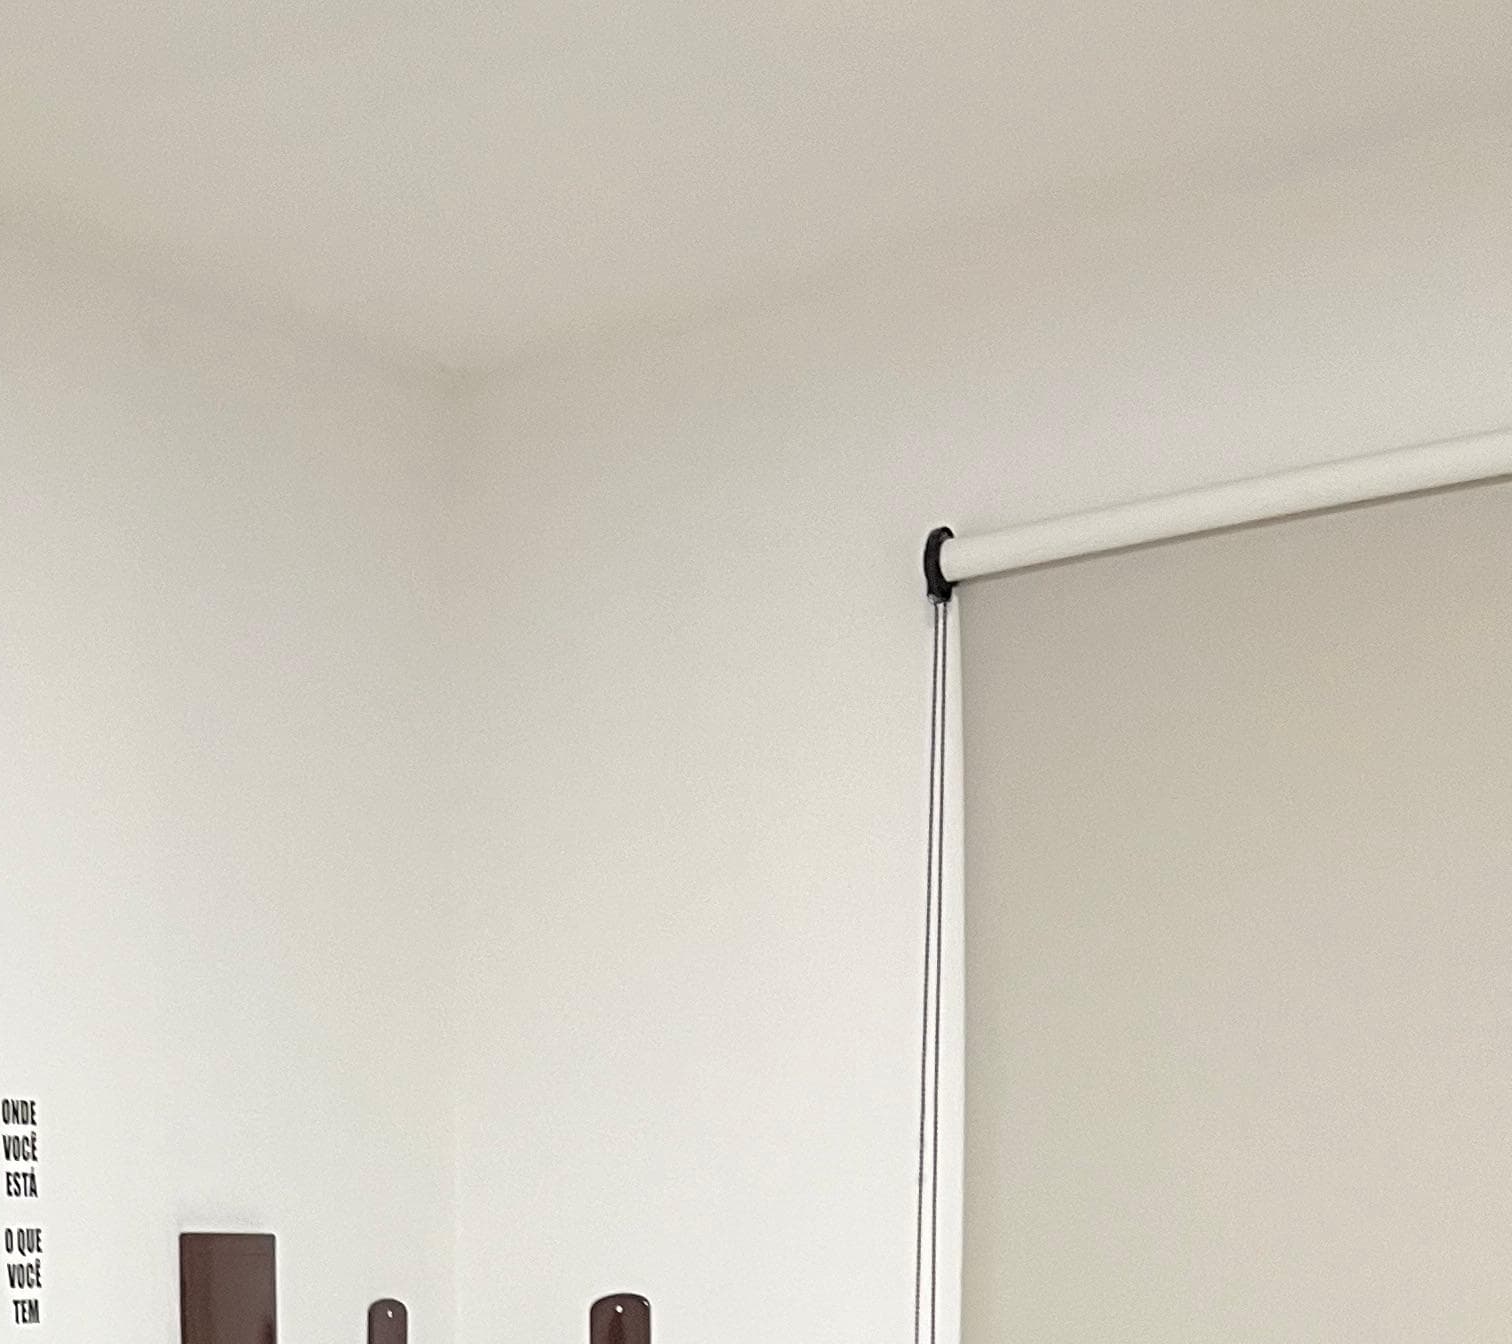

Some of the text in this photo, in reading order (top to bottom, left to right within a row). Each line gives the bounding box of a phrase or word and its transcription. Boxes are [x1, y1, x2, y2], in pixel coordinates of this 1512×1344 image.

[1, 1098, 37, 1126] ONDE
[1, 1130, 38, 1162] VOCÊ
[5, 1165, 38, 1198] ESTÁ
[4, 1227, 43, 1257] O QUE
[6, 1257, 42, 1289] VOCÊ
[12, 1298, 40, 1324] TEM
